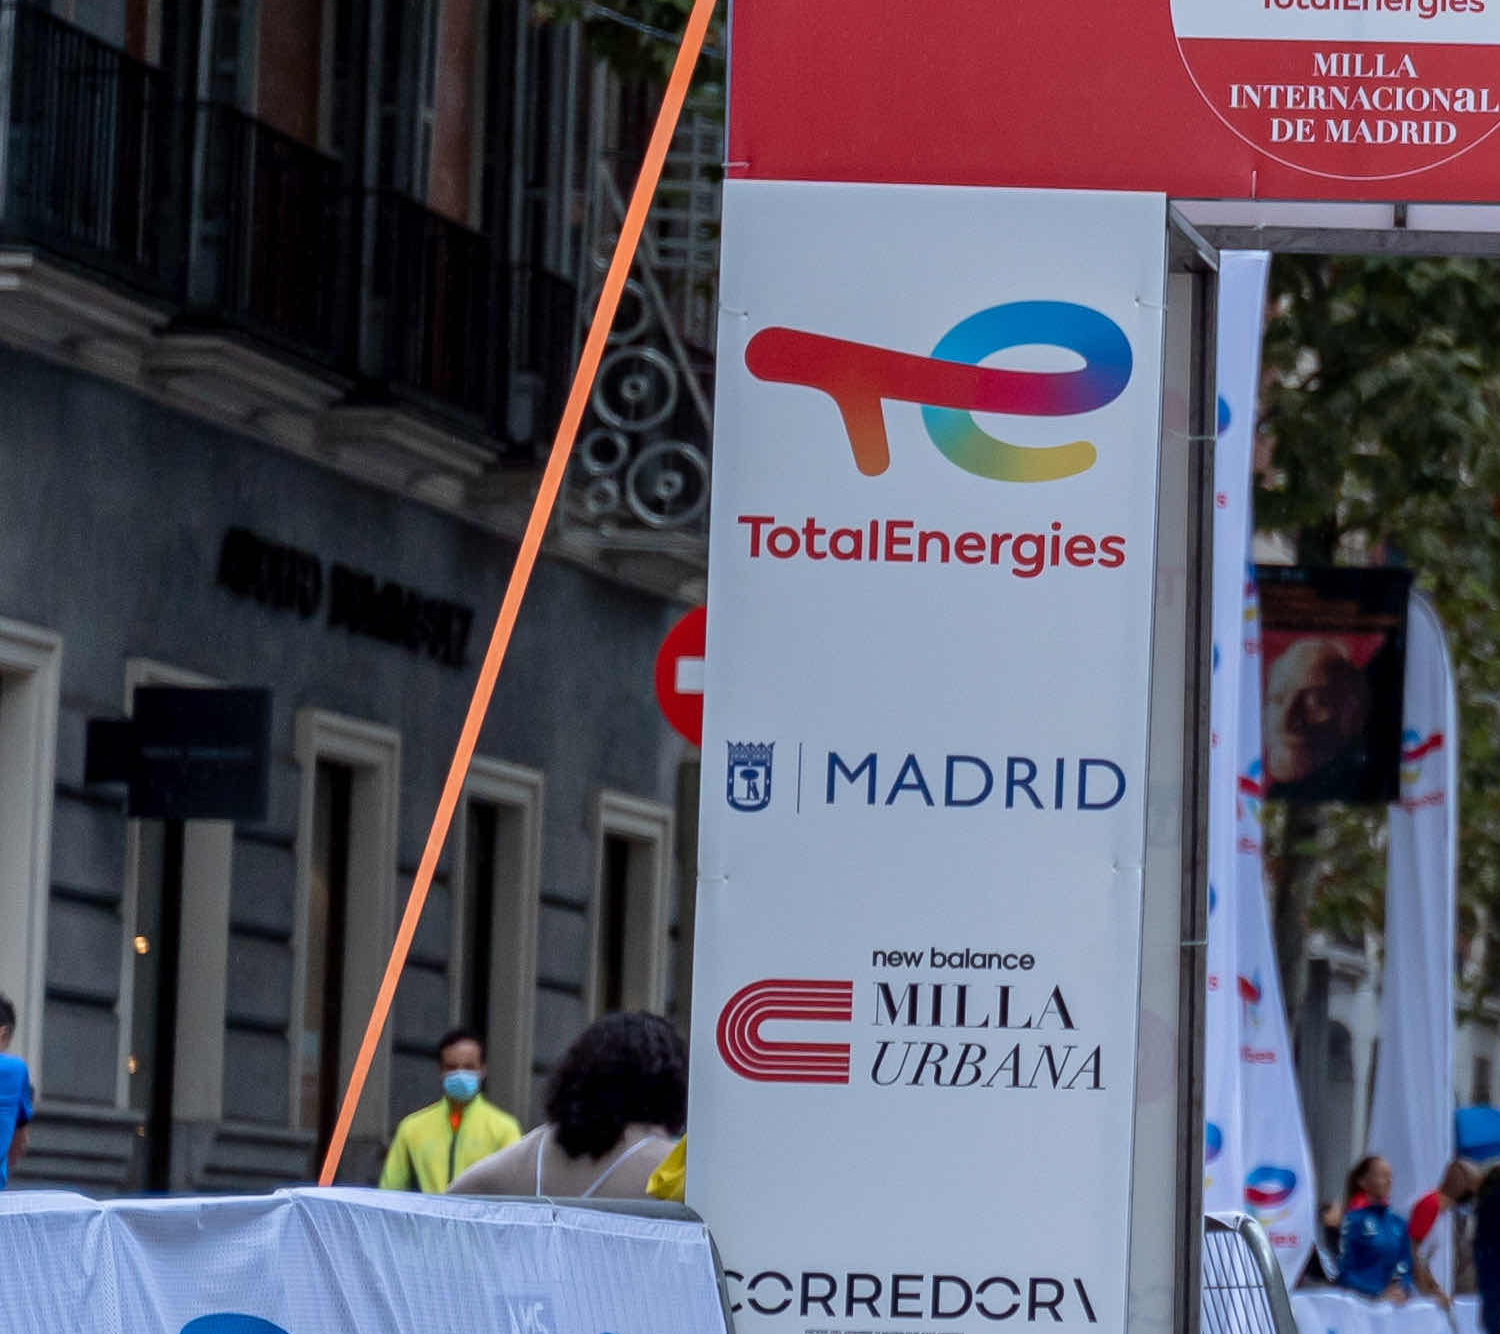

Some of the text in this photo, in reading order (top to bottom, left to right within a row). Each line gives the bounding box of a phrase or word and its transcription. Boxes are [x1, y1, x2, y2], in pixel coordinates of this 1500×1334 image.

[1312, 51, 1419, 79] MILLA
[1270, 117, 1458, 146] DE MADRID
[737, 514, 1126, 579] TotalEnergies
[825, 750, 1128, 812] MADRID
[871, 945, 1037, 972] new balance
[874, 981, 1076, 1031] MILLA
[870, 1039, 1107, 1091] URBANA
